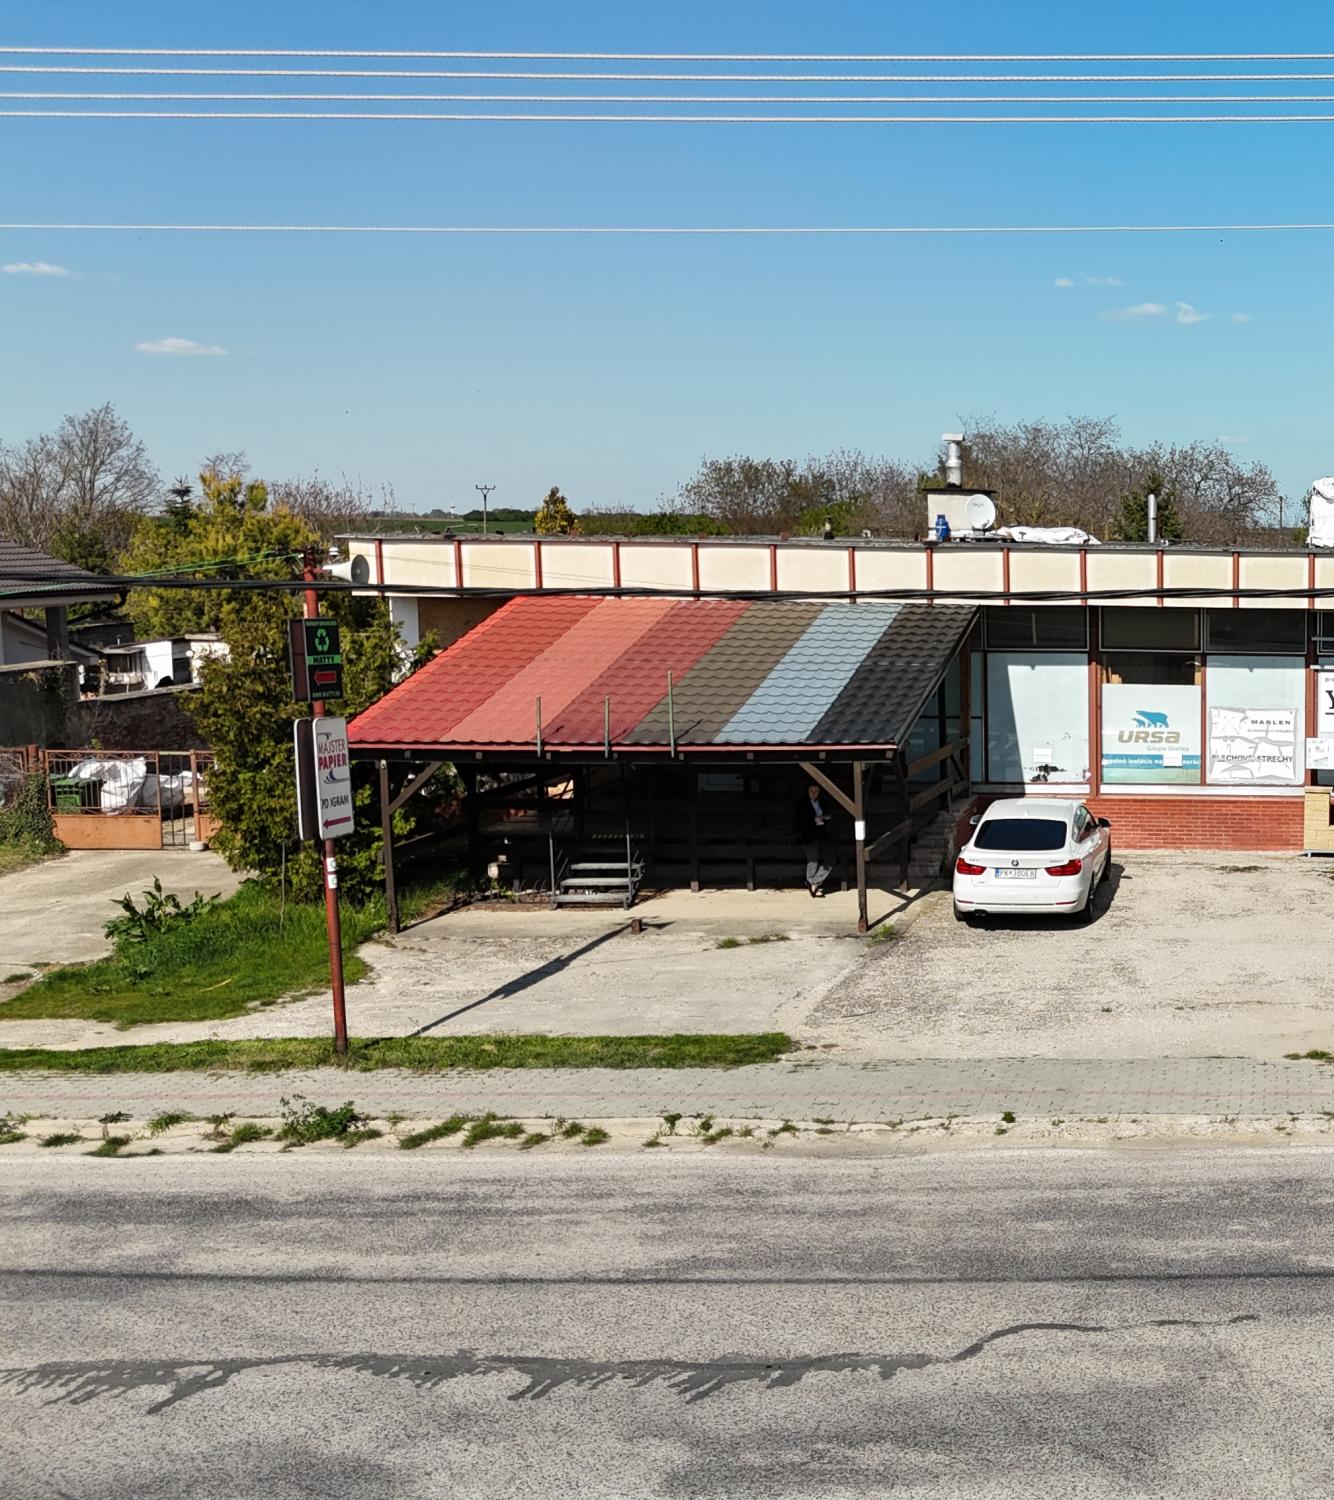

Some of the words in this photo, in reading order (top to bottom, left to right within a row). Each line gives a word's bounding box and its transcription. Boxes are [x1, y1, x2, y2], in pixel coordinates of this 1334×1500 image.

[312, 656, 335, 664] MATTY
[318, 738, 346, 754] MAJSTER
[318, 753, 348, 770] PAPIER
